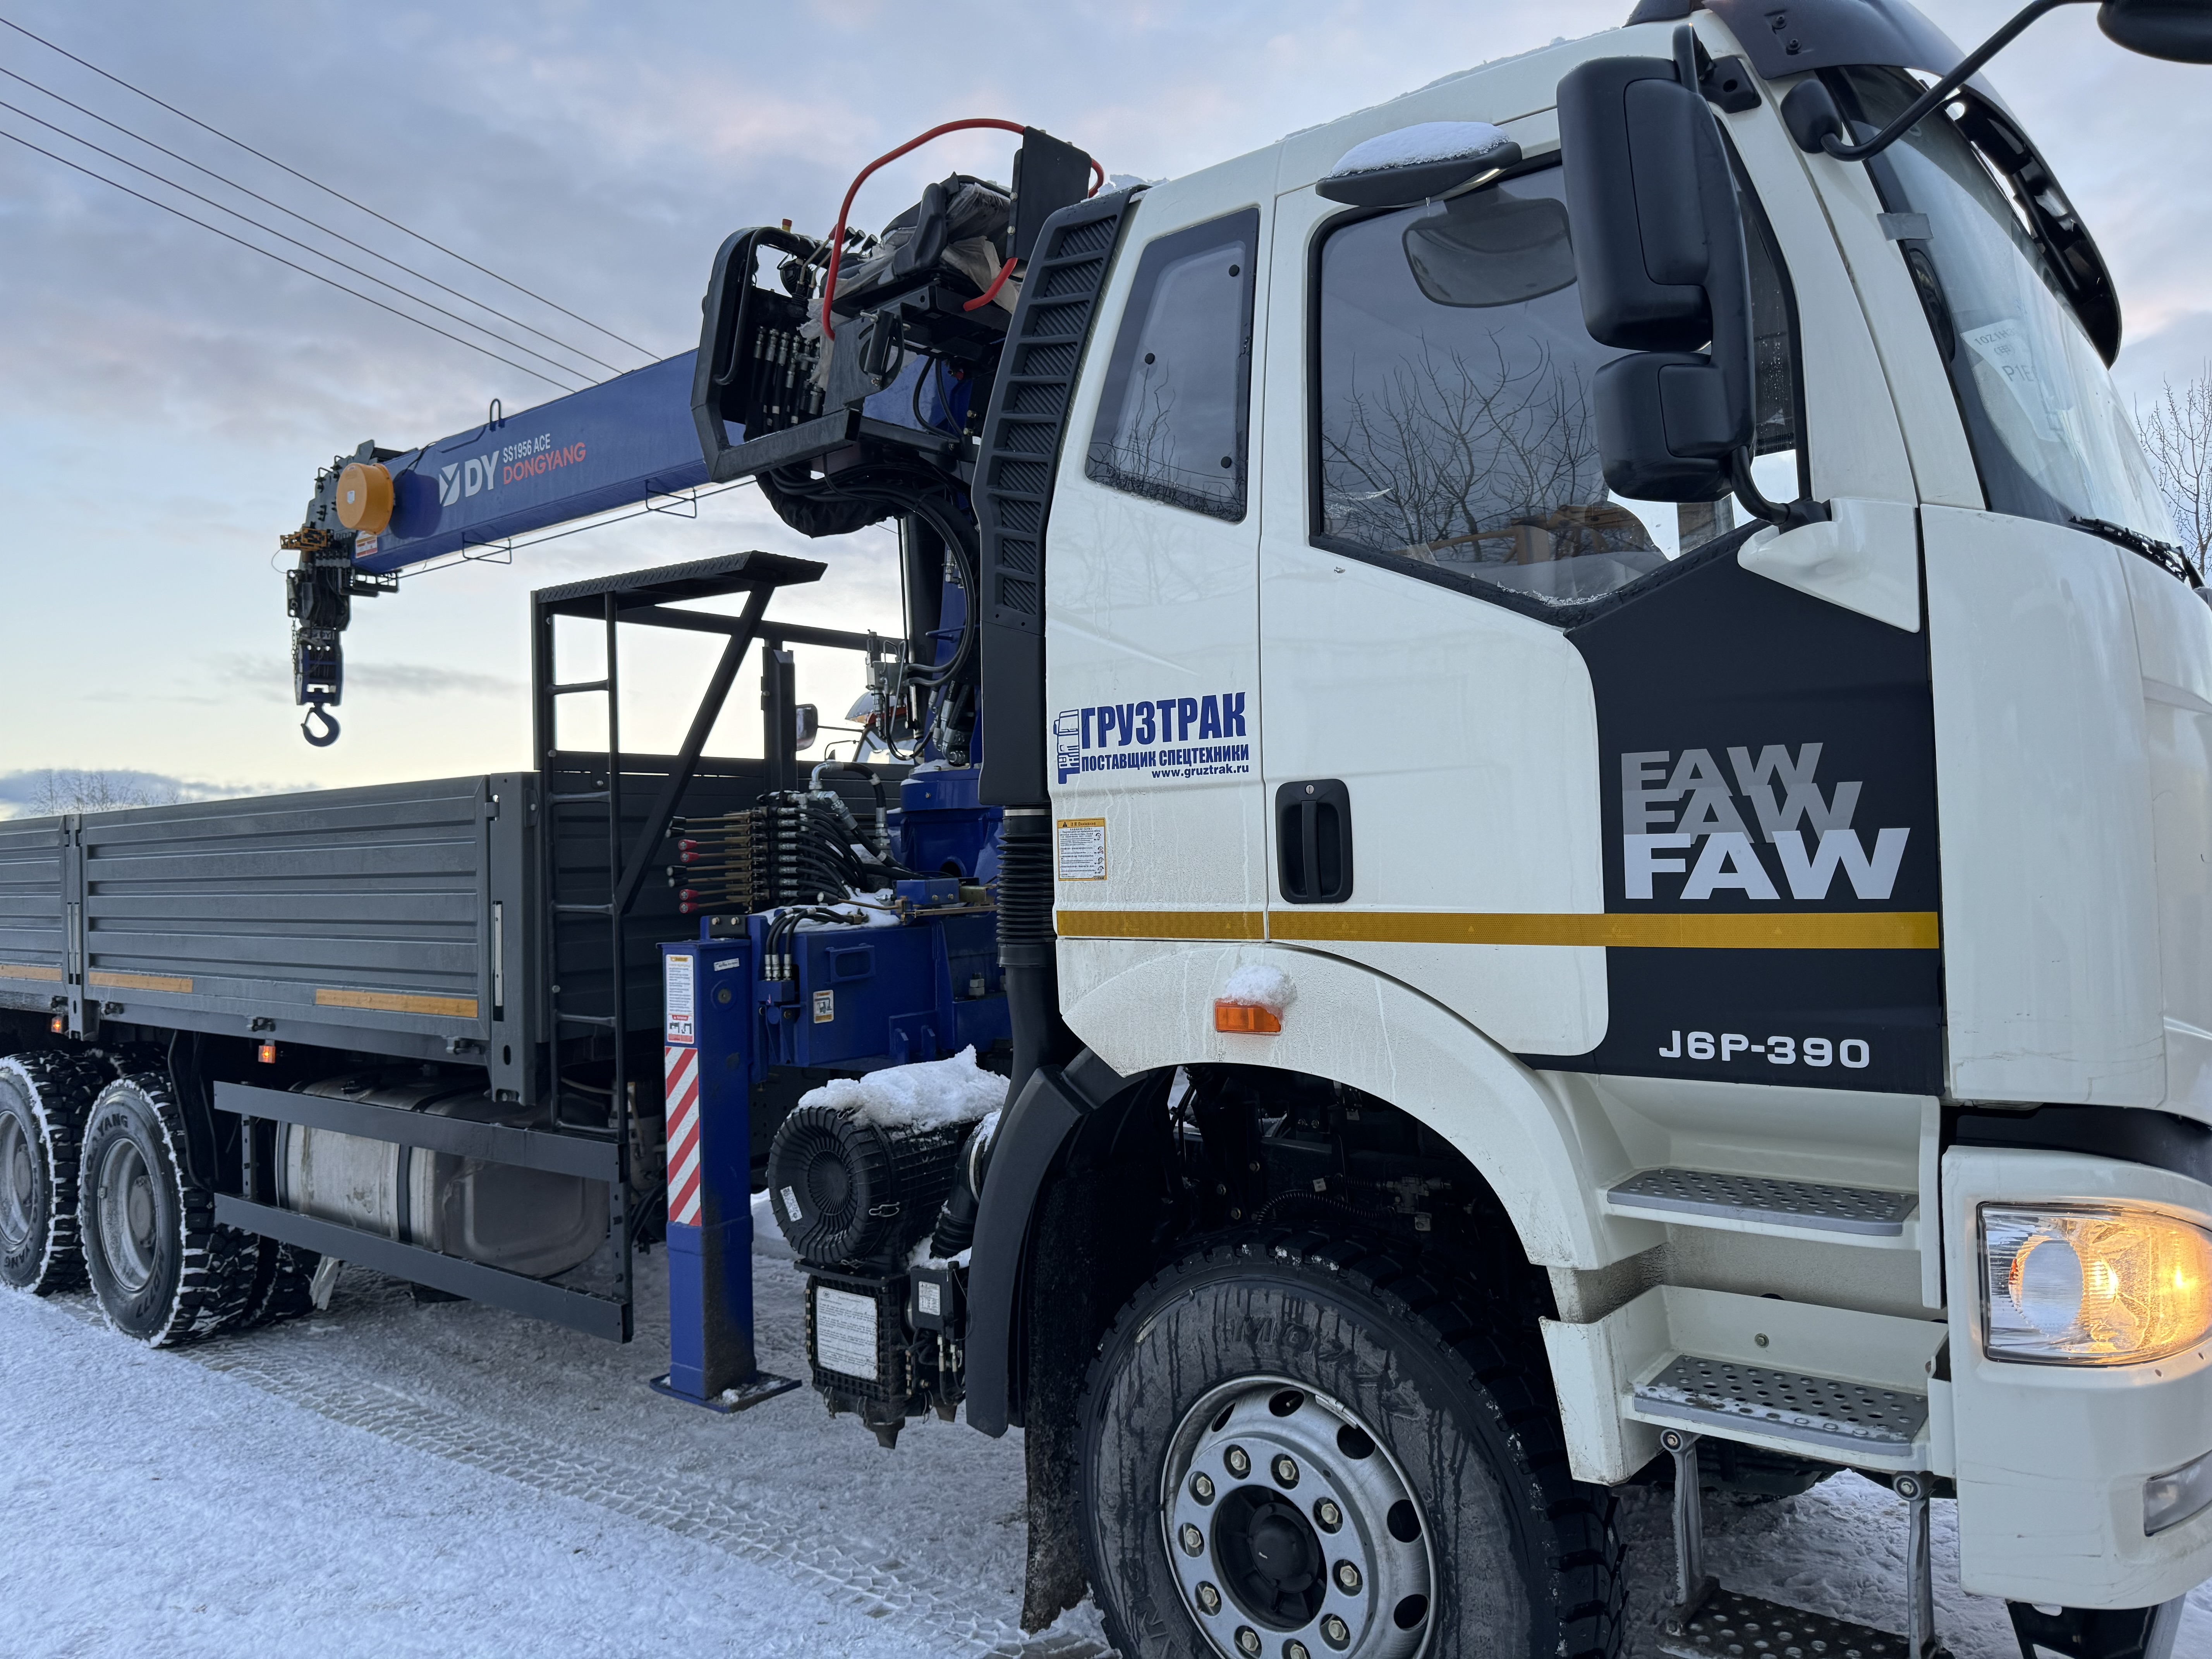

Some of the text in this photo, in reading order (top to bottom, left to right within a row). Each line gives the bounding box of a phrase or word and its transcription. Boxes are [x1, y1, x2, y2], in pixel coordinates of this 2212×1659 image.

[503, 433, 550, 463] SS1956 ACE
[503, 442, 586, 485] DONGYANG
[465, 450, 500, 497] DY
[1081, 692, 1246, 749] ГРУЗТРАК
[1082, 744, 1249, 772] ПОСТАВЩИК СПЕЦТЕХНИКИ
[1151, 764, 1249, 778] www.gruztrak.ru
[1621, 742, 1824, 797] FAW
[1622, 781, 1863, 844] FAW
[1624, 828, 1911, 900] FAW
[1659, 1030, 1870, 1068] J6P-390
[97, 1113, 129, 1137] YANG
